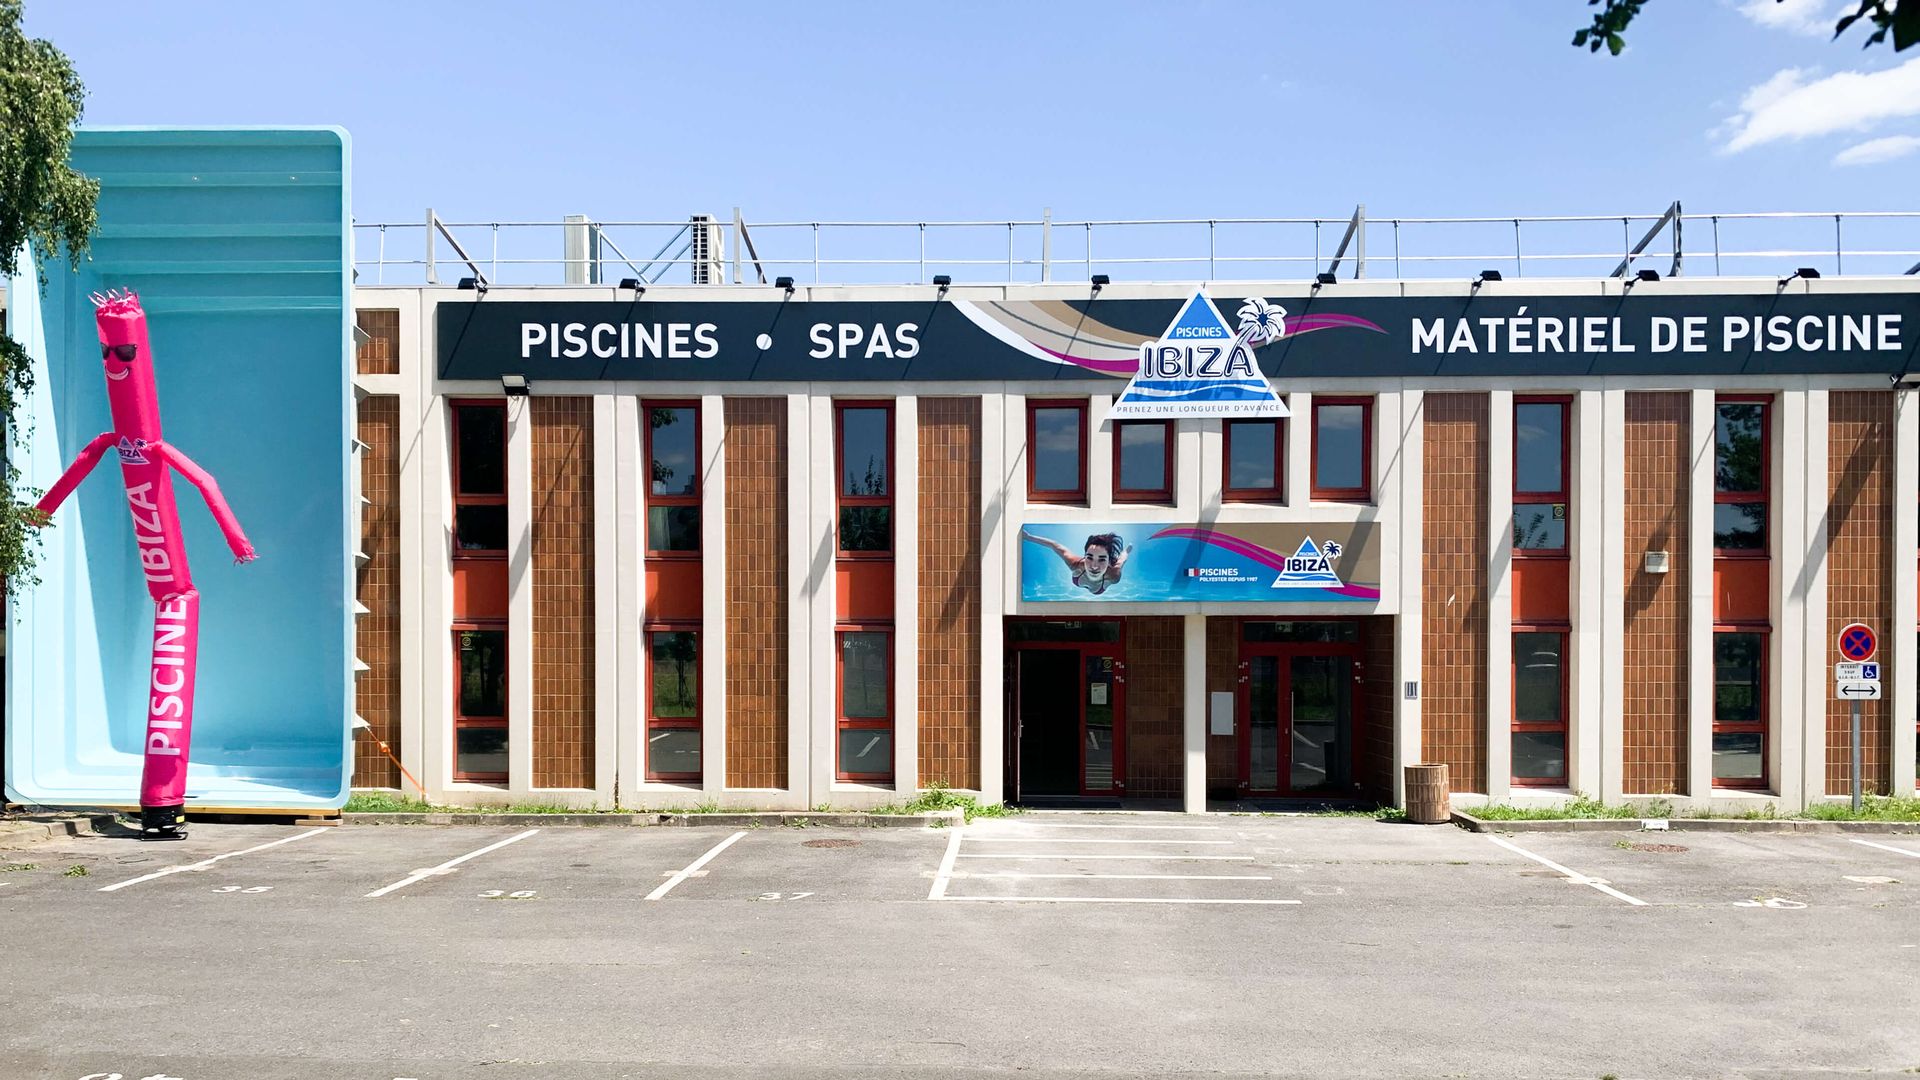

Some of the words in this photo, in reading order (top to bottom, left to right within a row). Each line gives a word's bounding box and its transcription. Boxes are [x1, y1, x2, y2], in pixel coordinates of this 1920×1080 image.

[1175, 326, 1222, 338] PISCINES
[1411, 306, 1636, 353] MATÉRIEL
[1651, 316, 1708, 353] DE
[1723, 314, 1903, 352] PISCINE
[521, 322, 719, 359] PISCINES
[808, 322, 920, 359] SPAS
[1144, 345, 1254, 378] IBIZA
[1178, 405, 1230, 413] LONGUEUR
[1234, 404, 1281, 412] D'AVANCE
[126, 481, 174, 583] IBIZA
[1199, 568, 1239, 576] PISCINES
[1286, 558, 1330, 572] IBIZA
[759, 892, 815, 900] 37
